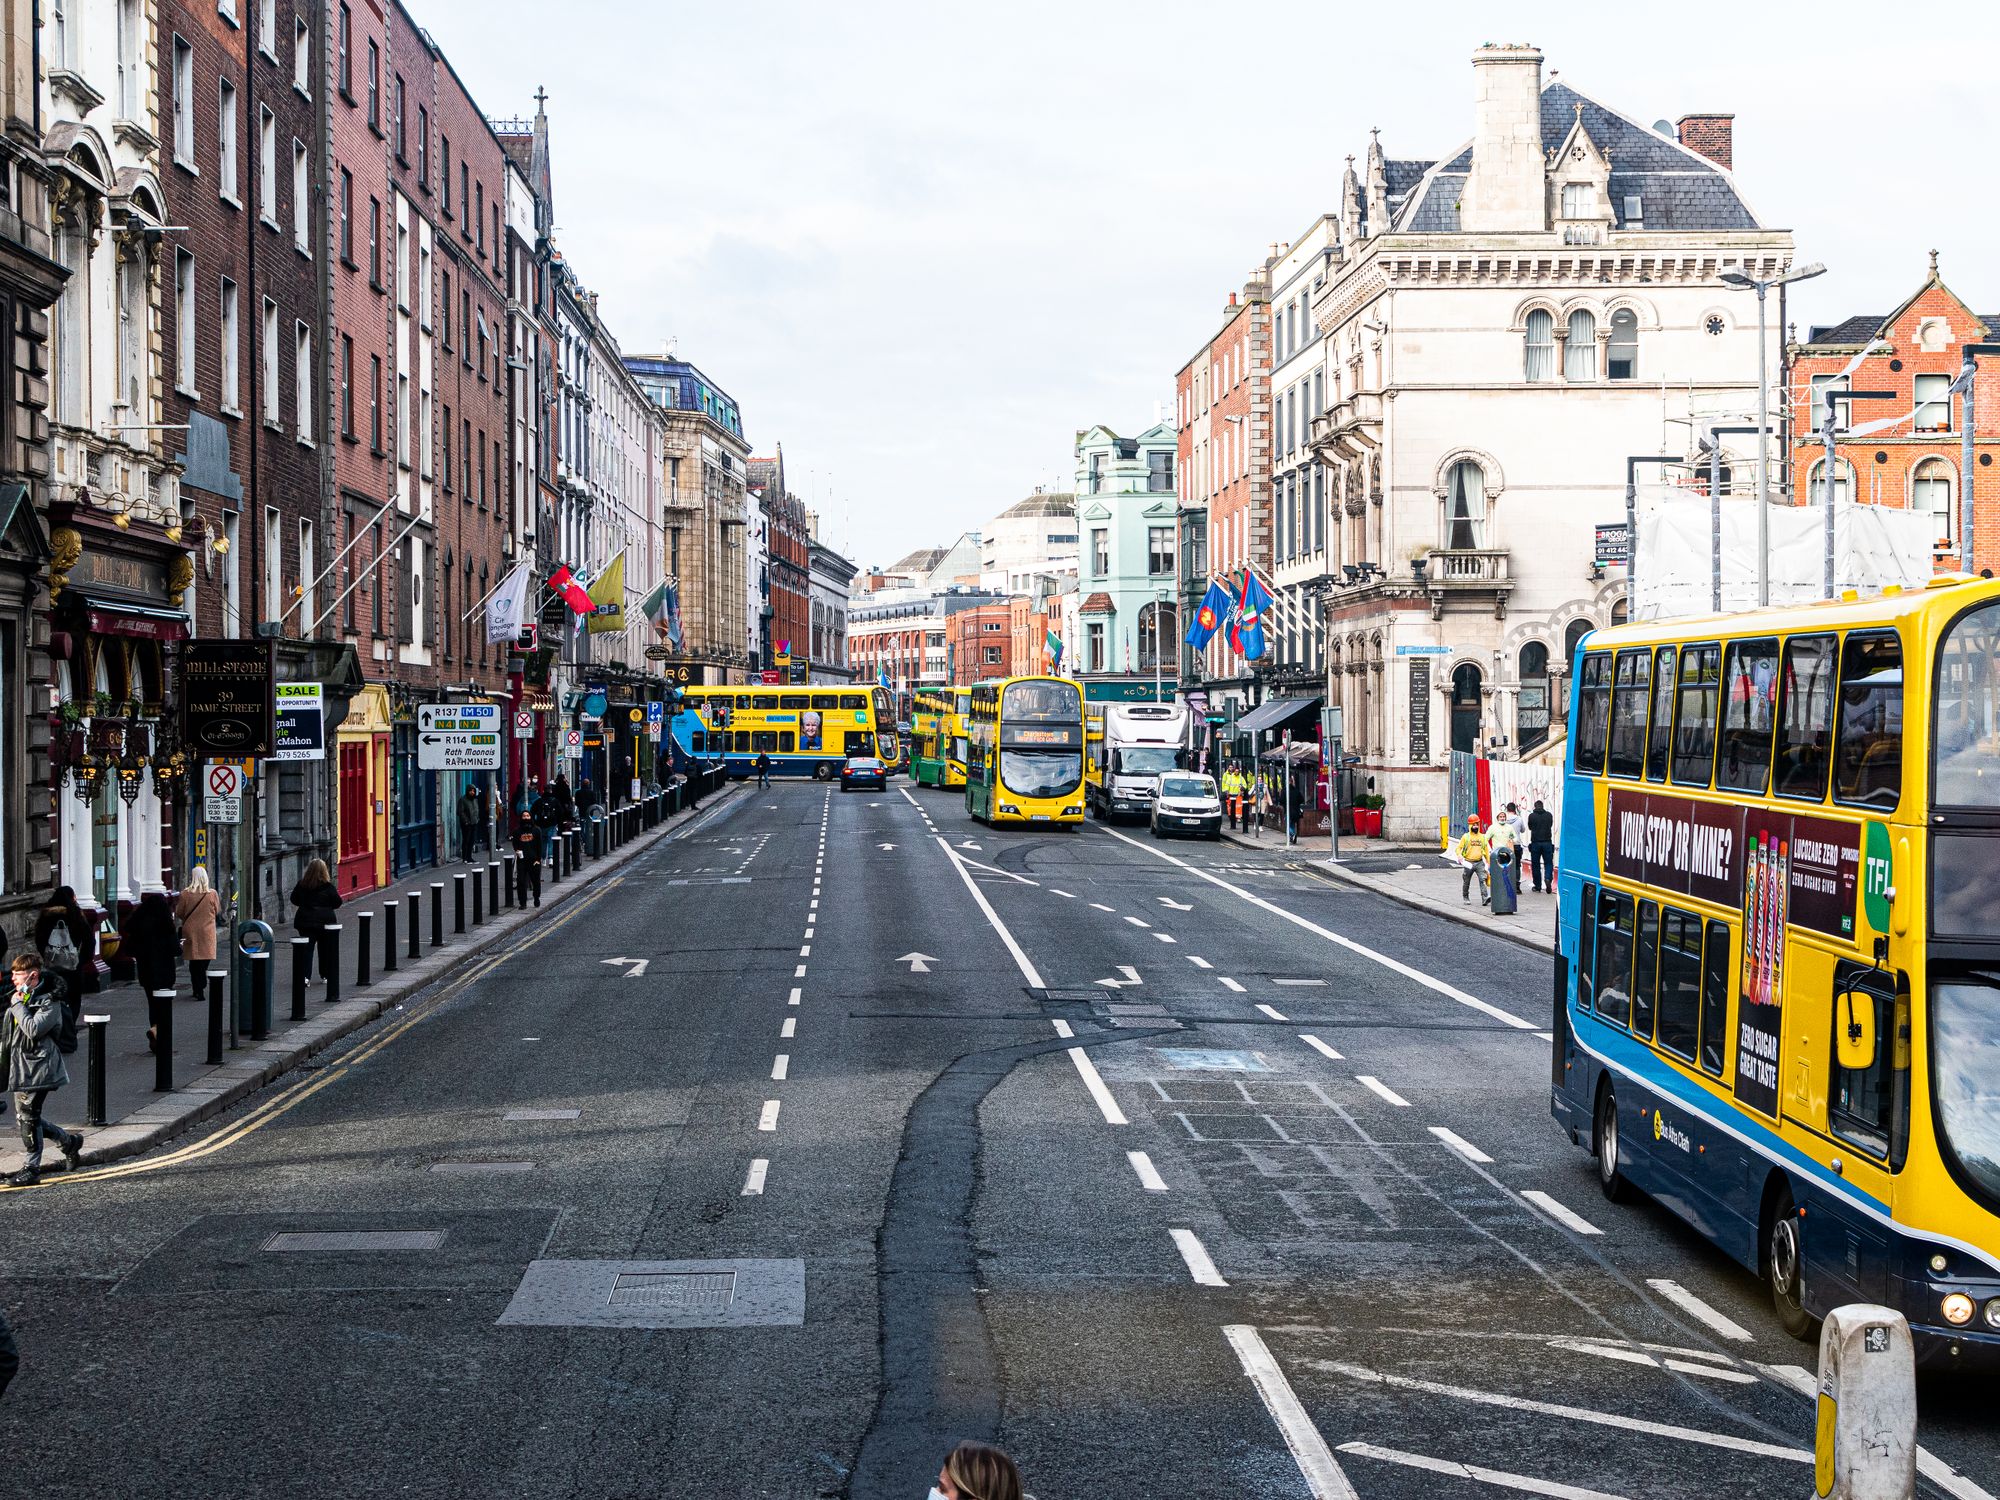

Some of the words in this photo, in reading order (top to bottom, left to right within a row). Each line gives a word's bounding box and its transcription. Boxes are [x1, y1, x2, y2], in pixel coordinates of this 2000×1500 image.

[1602, 530, 1627, 538] BROGA
[489, 622, 514, 630] anguage
[185, 661, 267, 673] MILLSTONE
[218, 691, 234, 702] 39
[286, 686, 315, 696] SALE
[190, 703, 219, 713] DAME
[222, 703, 261, 713] STREET
[652, 703, 659, 712] P
[276, 718, 296, 729] gnall
[277, 737, 312, 746] cMahon
[1062, 731, 1069, 743] 9
[277, 751, 291, 759] 679
[292, 750, 311, 759] 5265
[465, 748, 495, 756] Maonais
[445, 757, 494, 766] RATHMINES
[1620, 810, 1645, 860] YOUR
[1646, 814, 1673, 867] STOP
[1674, 819, 1690, 872] OR
[1691, 823, 1733, 881] MINE?
[1793, 838, 1822, 863] LUCOZADE
[1822, 843, 1839, 867] ZERO
[1867, 857, 1889, 894] TFI
[1792, 871, 1803, 888] ZERO
[1804, 874, 1821, 892] SUGARS
[1821, 878, 1837, 895] GIVEN
[1741, 1022, 1755, 1052] ZERO
[1755, 1029, 1778, 1062] SUGAR
[1740, 1050, 1757, 1081] GREAT
[1758, 1059, 1777, 1090] TASTE
